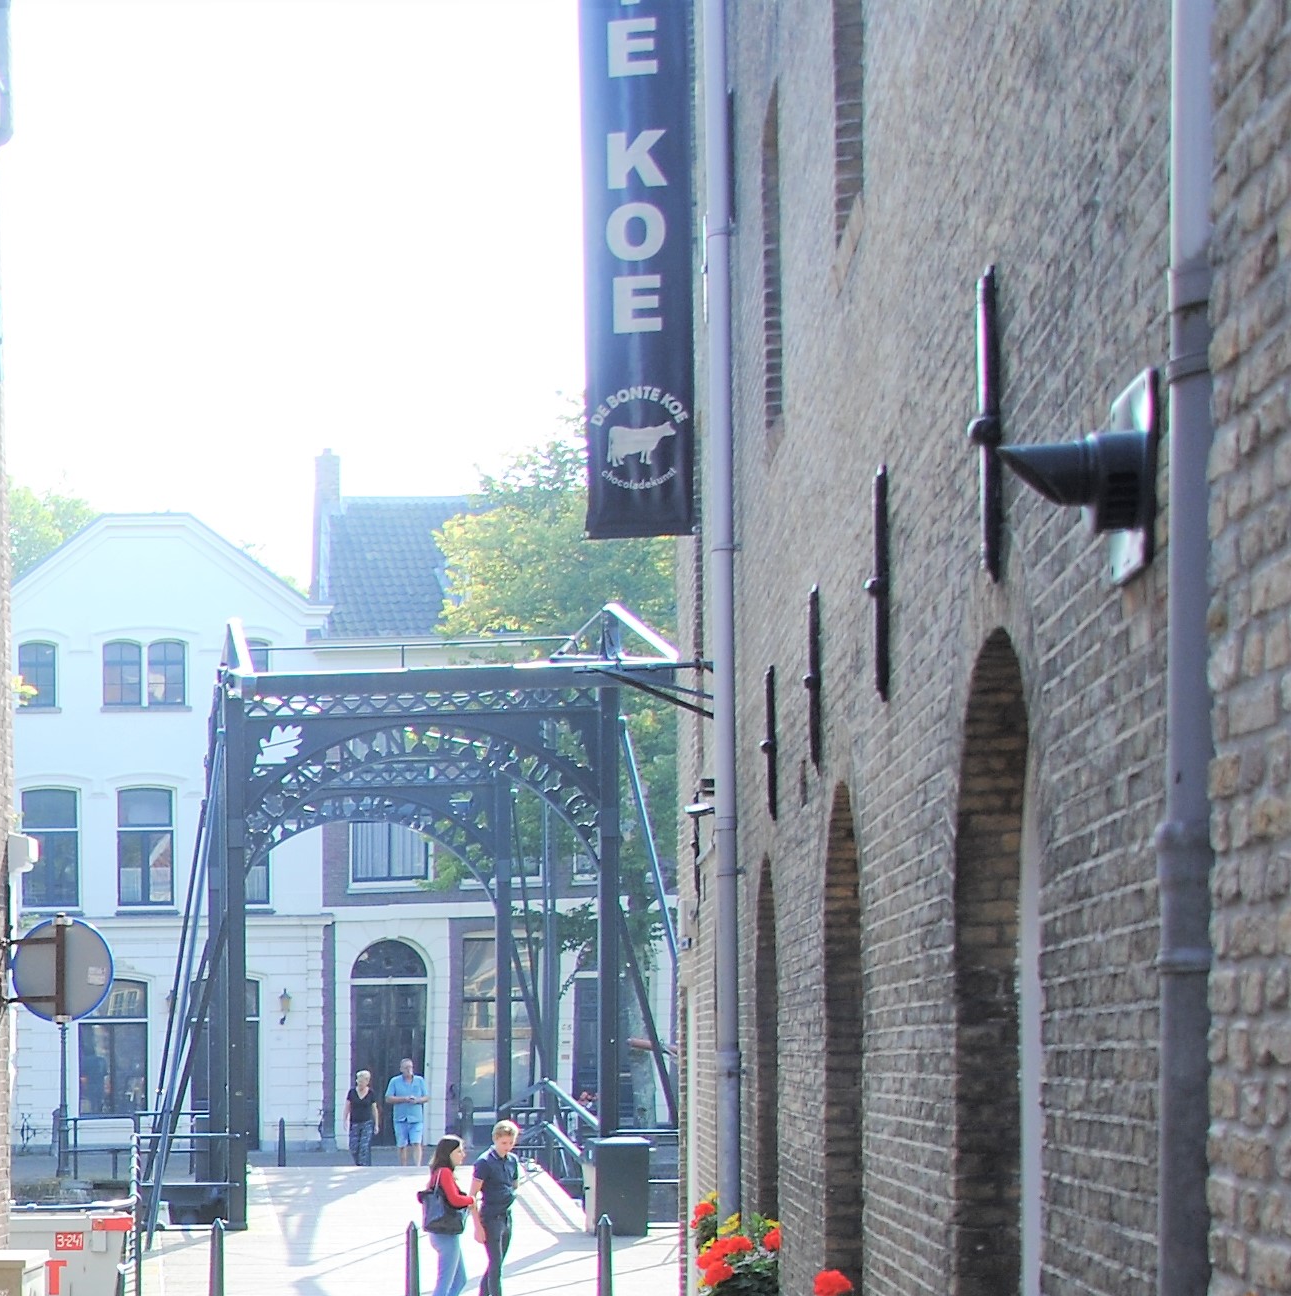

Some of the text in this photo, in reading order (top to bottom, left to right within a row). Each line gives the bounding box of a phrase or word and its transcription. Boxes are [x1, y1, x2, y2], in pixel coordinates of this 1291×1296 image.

[605, 0, 668, 334] E KOE
[590, 386, 688, 426] DE BONTE KOE
[601, 467, 677, 490] chocoladekunst
[56, 1234, 83, 1247] 3-241
